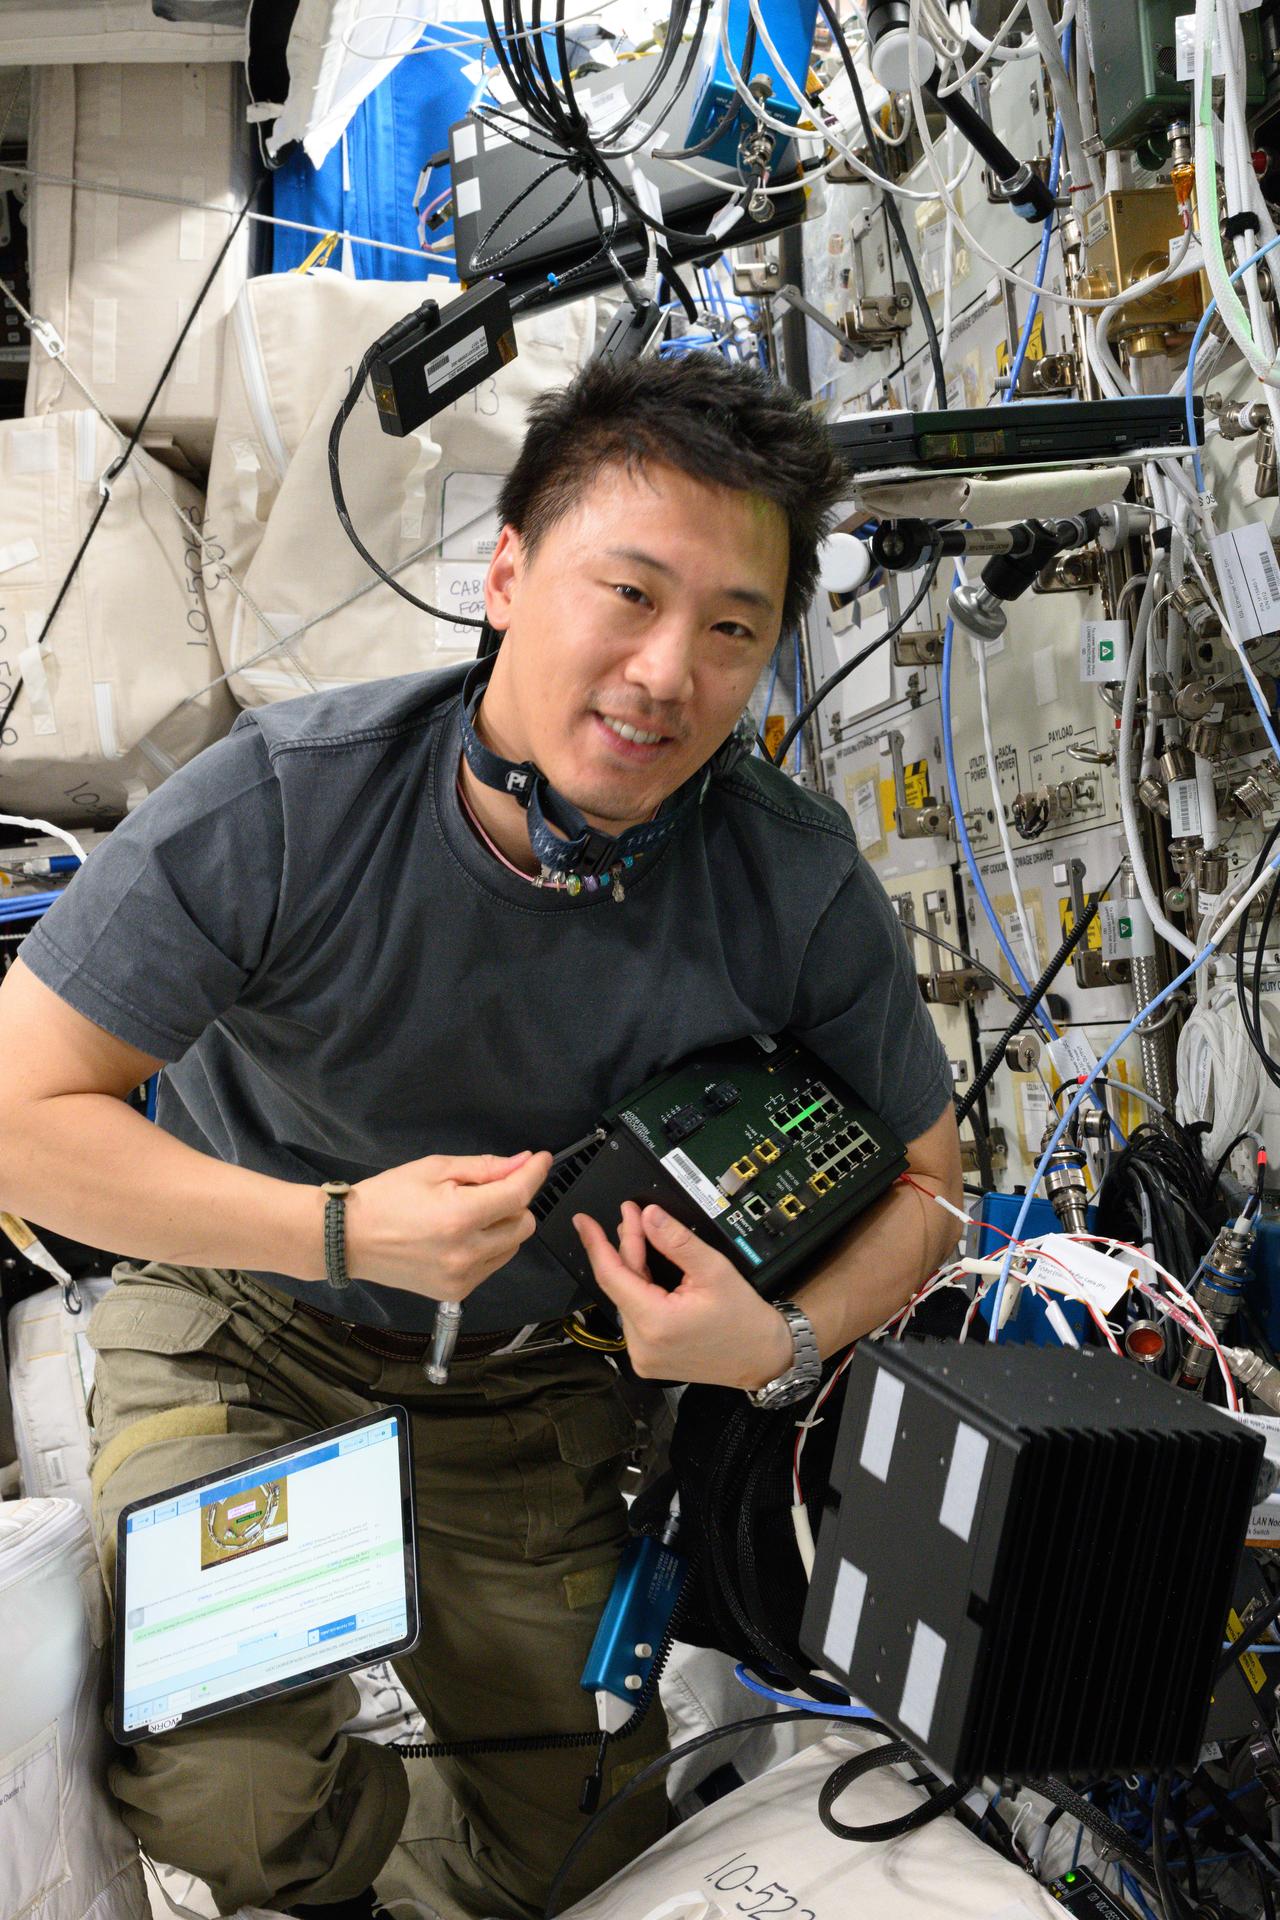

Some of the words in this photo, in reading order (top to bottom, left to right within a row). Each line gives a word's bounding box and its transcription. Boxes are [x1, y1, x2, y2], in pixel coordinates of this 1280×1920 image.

[1048, 724, 1074, 743] PAYLOAD
[968, 754, 986, 770] UTILITY
[970, 767, 987, 782] POWER
[736, 1237, 761, 1265] SIEMENS
